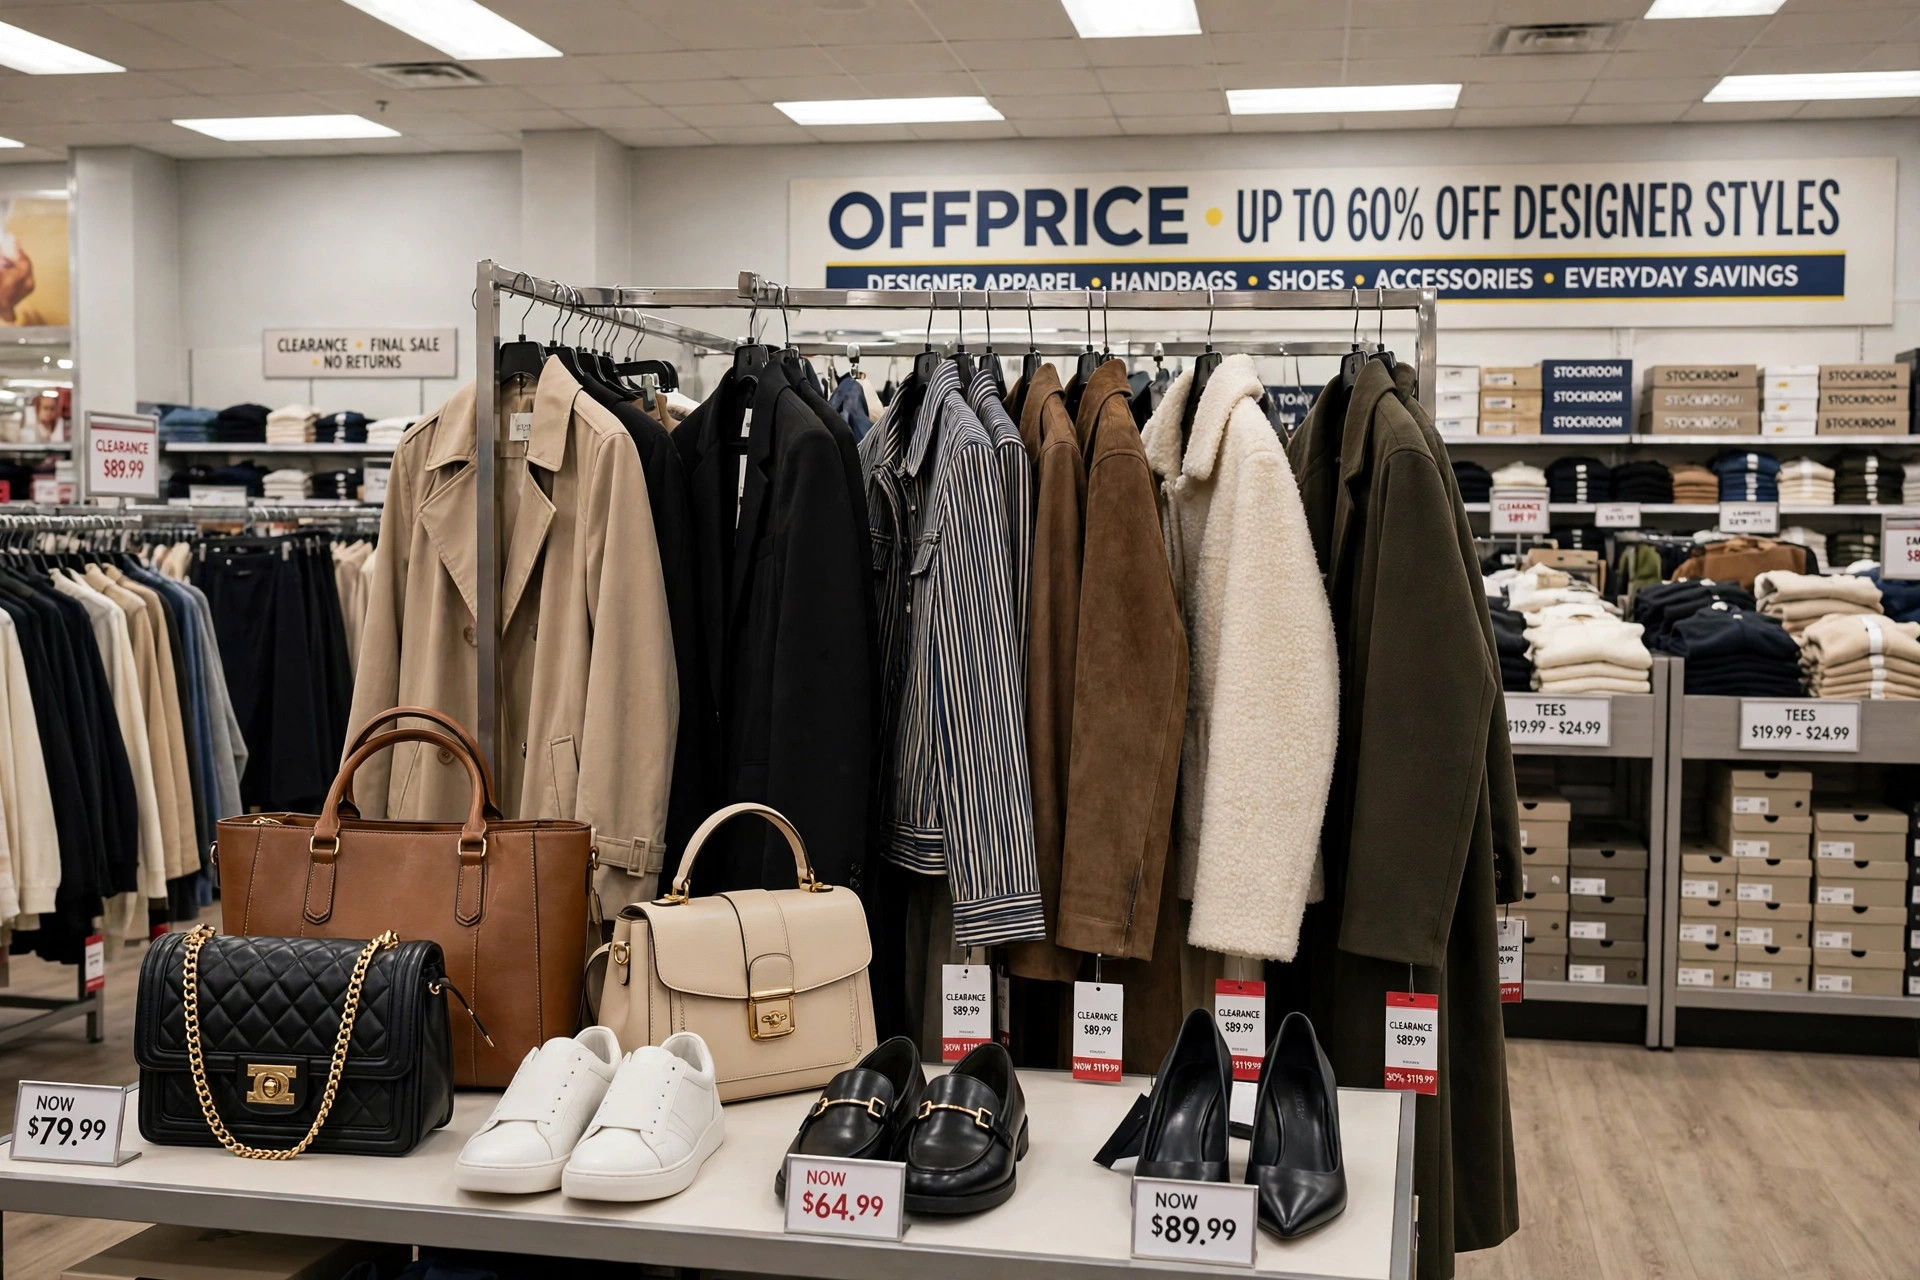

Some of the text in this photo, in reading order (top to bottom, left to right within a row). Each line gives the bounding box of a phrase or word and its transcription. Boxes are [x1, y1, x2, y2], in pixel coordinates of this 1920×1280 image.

[1237, 179, 1839, 243] UP TO 60% OFF DESIGNER STYLES
[828, 186, 1188, 250] OFFPRICE
[867, 264, 1799, 291] DESIGNER APPAREL HANDBAGS SHOES ACCESSORIES EVERYDAY SAVINGS
[277, 337, 440, 352] CLEARANCE FINAL SALE
[324, 355, 401, 369] NO RETURNS
[1553, 366, 1622, 378] STOCKROOM
[1665, 370, 1739, 381] STOCKROOM
[1828, 370, 1896, 381] STOCKROOM
[1553, 391, 1622, 402] STOCKROOM
[1828, 394, 1896, 405] STOCKROOM
[1553, 415, 1622, 428] STOCKROOM
[1826, 417, 1896, 428] STOCKROOM
[96, 439, 149, 455] CLEARANCE
[104, 458, 144, 479] $89.99
[1536, 704, 1566, 716] TEES
[1785, 709, 1816, 721] TEES
[1558, 720, 1601, 735] $24.99
[1752, 724, 1792, 739] $19.99
[1806, 726, 1850, 740] $24.99
[945, 993, 986, 1002] CLEARANCE
[953, 1005, 980, 1016] $89.99
[1077, 1011, 1118, 1021] CLEARANCE
[1218, 1008, 1260, 1019] CLEARANCE
[1084, 1024, 1112, 1035] $89.99
[1225, 1021, 1254, 1033] $89.99
[1389, 1021, 1433, 1032] CLEARANCE
[1396, 1034, 1426, 1046] $89.99
[36, 1094, 75, 1112] NOW
[27, 1115, 106, 1146] $79.99
[806, 1169, 846, 1187] NOW
[802, 1190, 884, 1221] $64.99
[1155, 1192, 1198, 1210] NOW
[1151, 1213, 1236, 1245] $89.99
